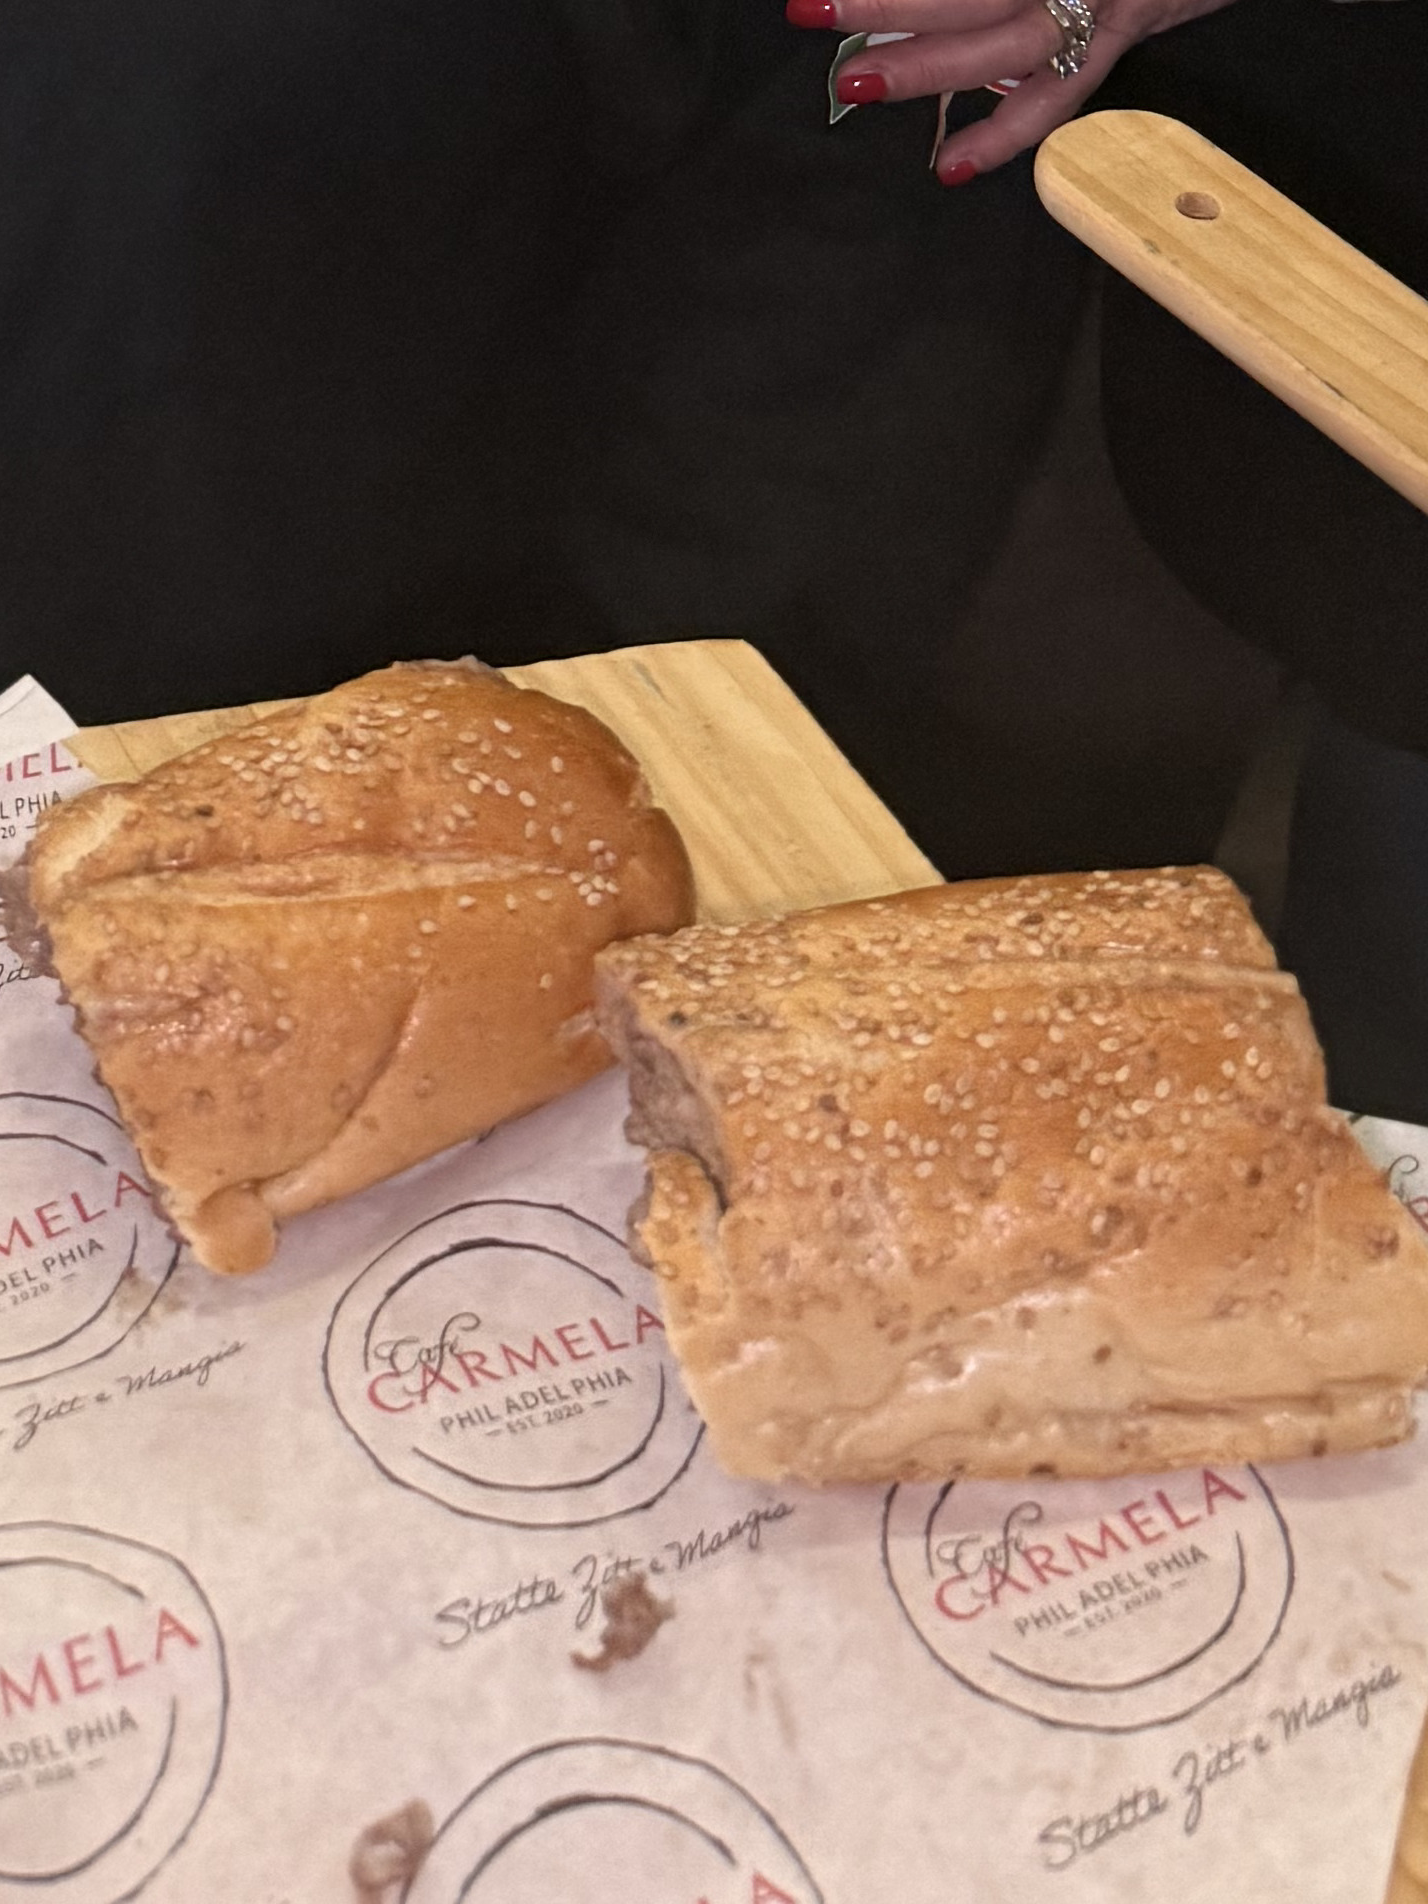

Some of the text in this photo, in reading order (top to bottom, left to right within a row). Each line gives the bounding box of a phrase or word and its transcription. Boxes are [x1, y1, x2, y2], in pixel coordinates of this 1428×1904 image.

[367, 1303, 667, 1416] CARMELA
[376, 1312, 482, 1401] Café
[934, 1468, 1247, 1621] CARMELA
